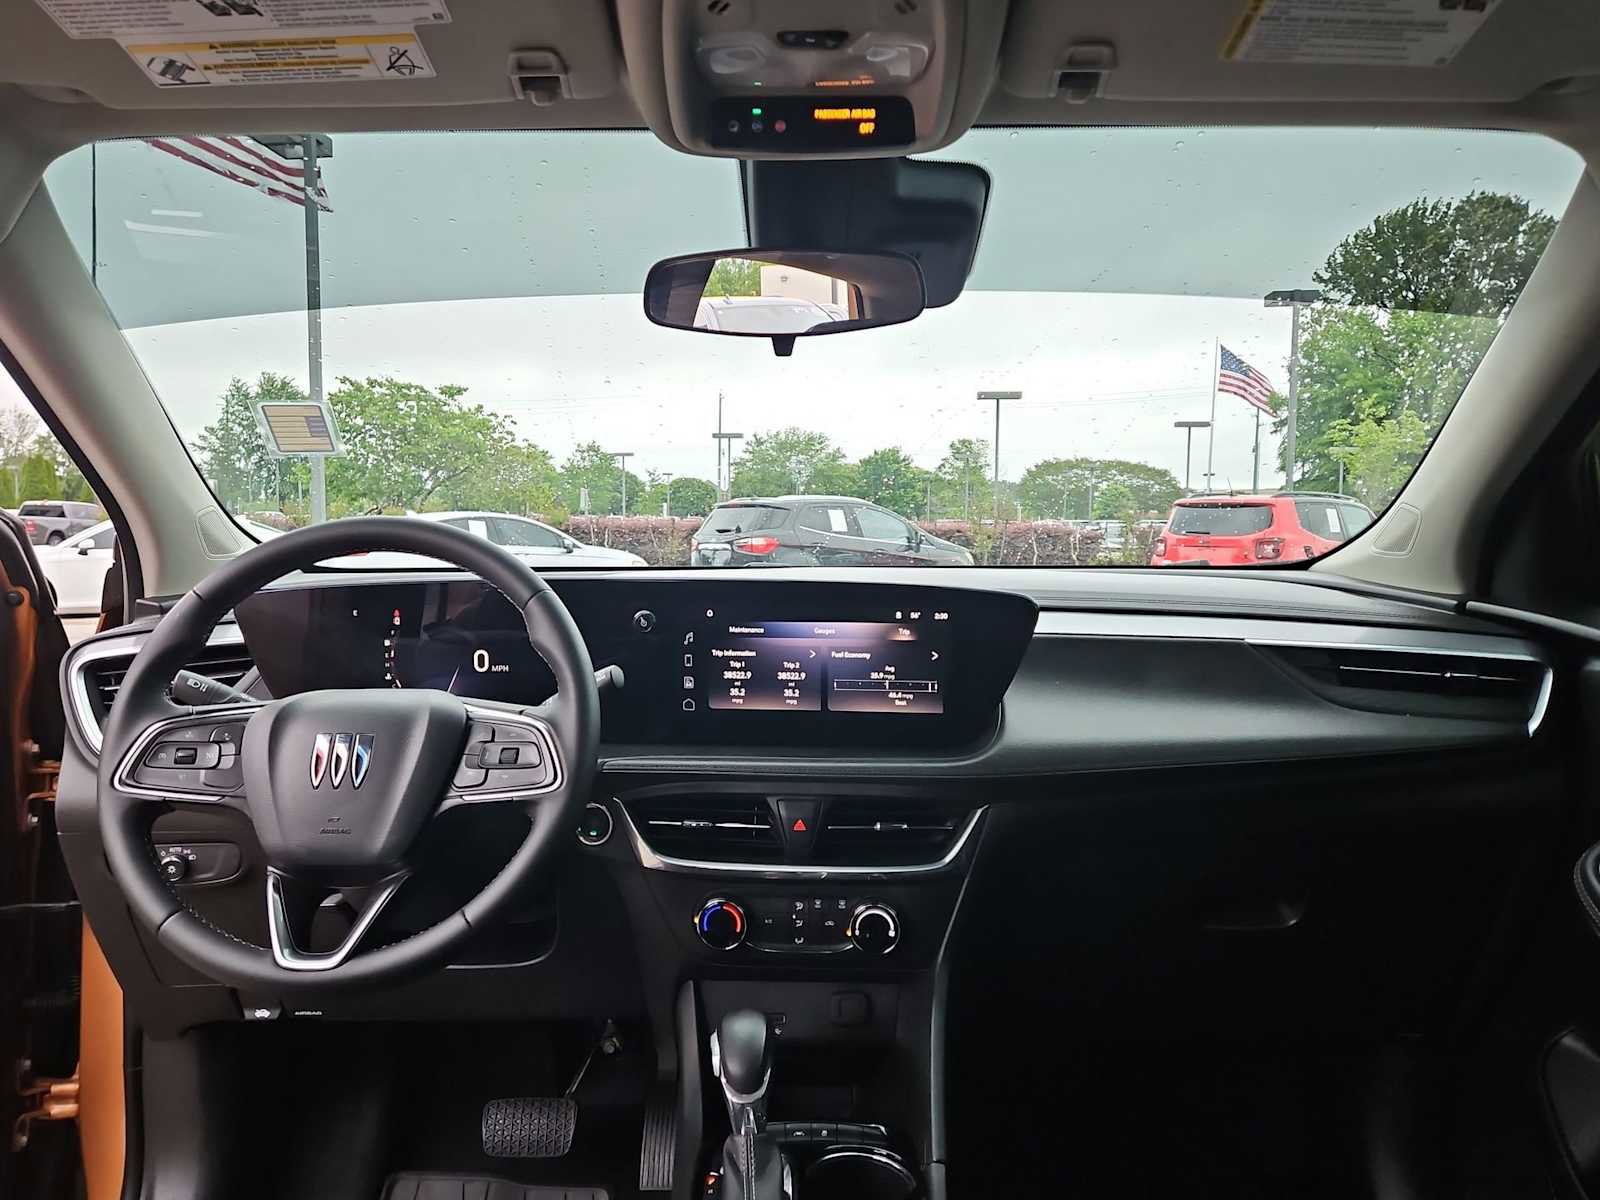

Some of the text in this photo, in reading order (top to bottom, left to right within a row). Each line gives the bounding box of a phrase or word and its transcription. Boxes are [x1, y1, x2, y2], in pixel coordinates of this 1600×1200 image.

[859, 122, 875, 134] OFF
[814, 627, 836, 635] Gauges
[898, 628, 910, 636] Trip
[712, 649, 756, 658] Trip Information
[844, 652, 871, 660] Economy
[474, 649, 489, 672] 0
[783, 662, 795, 670] Trip
[723, 671, 752, 679] 38522.9
[777, 672, 806, 680] 38522.9
[729, 688, 746, 696] 35.2
[784, 689, 800, 697] 35.2
